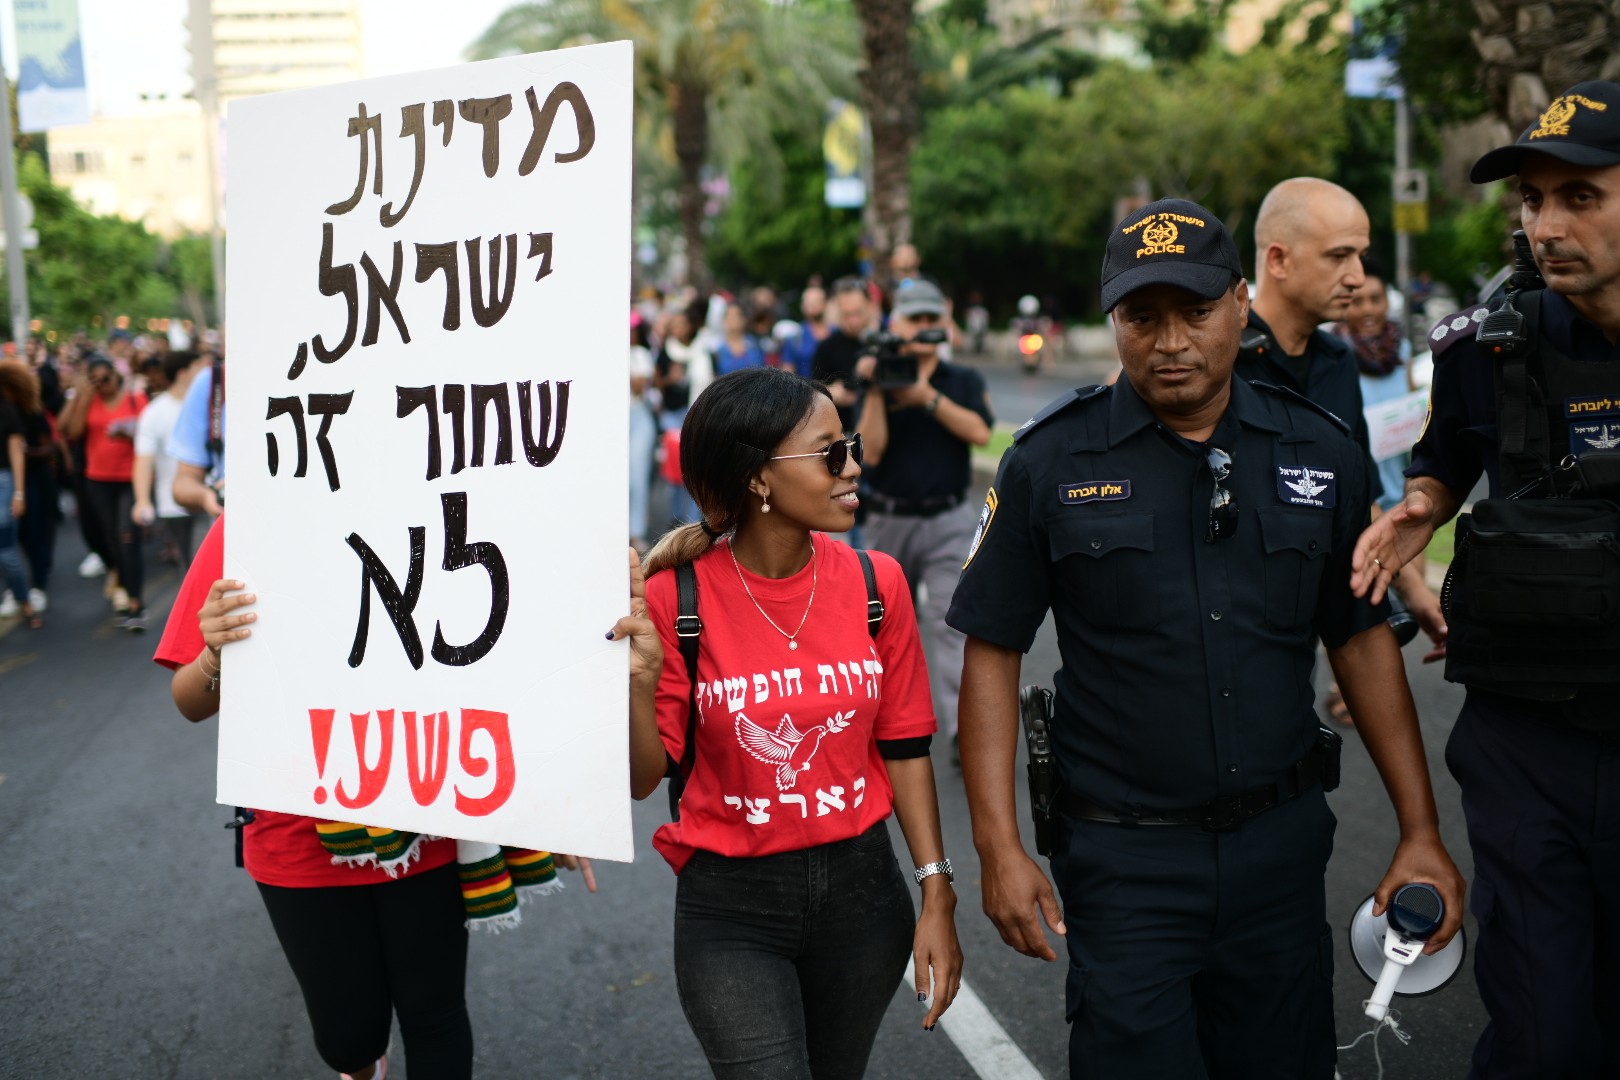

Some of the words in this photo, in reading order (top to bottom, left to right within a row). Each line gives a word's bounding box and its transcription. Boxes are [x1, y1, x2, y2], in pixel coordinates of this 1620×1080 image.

[1529, 125, 1571, 140] POLICE
[325, 81, 596, 228] מדינת
[1122, 214, 1156, 235] ישראל
[1158, 212, 1205, 228] משטרת
[1136, 244, 1185, 259] POLICE
[287, 222, 553, 381] ישראל,
[266, 389, 355, 492] זה
[396, 380, 572, 481] שחור
[1278, 466, 1302, 477] ישראל
[1068, 486, 1098, 499] אברה
[1101, 484, 1122, 498] אלון
[345, 491, 510, 671] לא
[308, 708, 516, 817] פשע!
